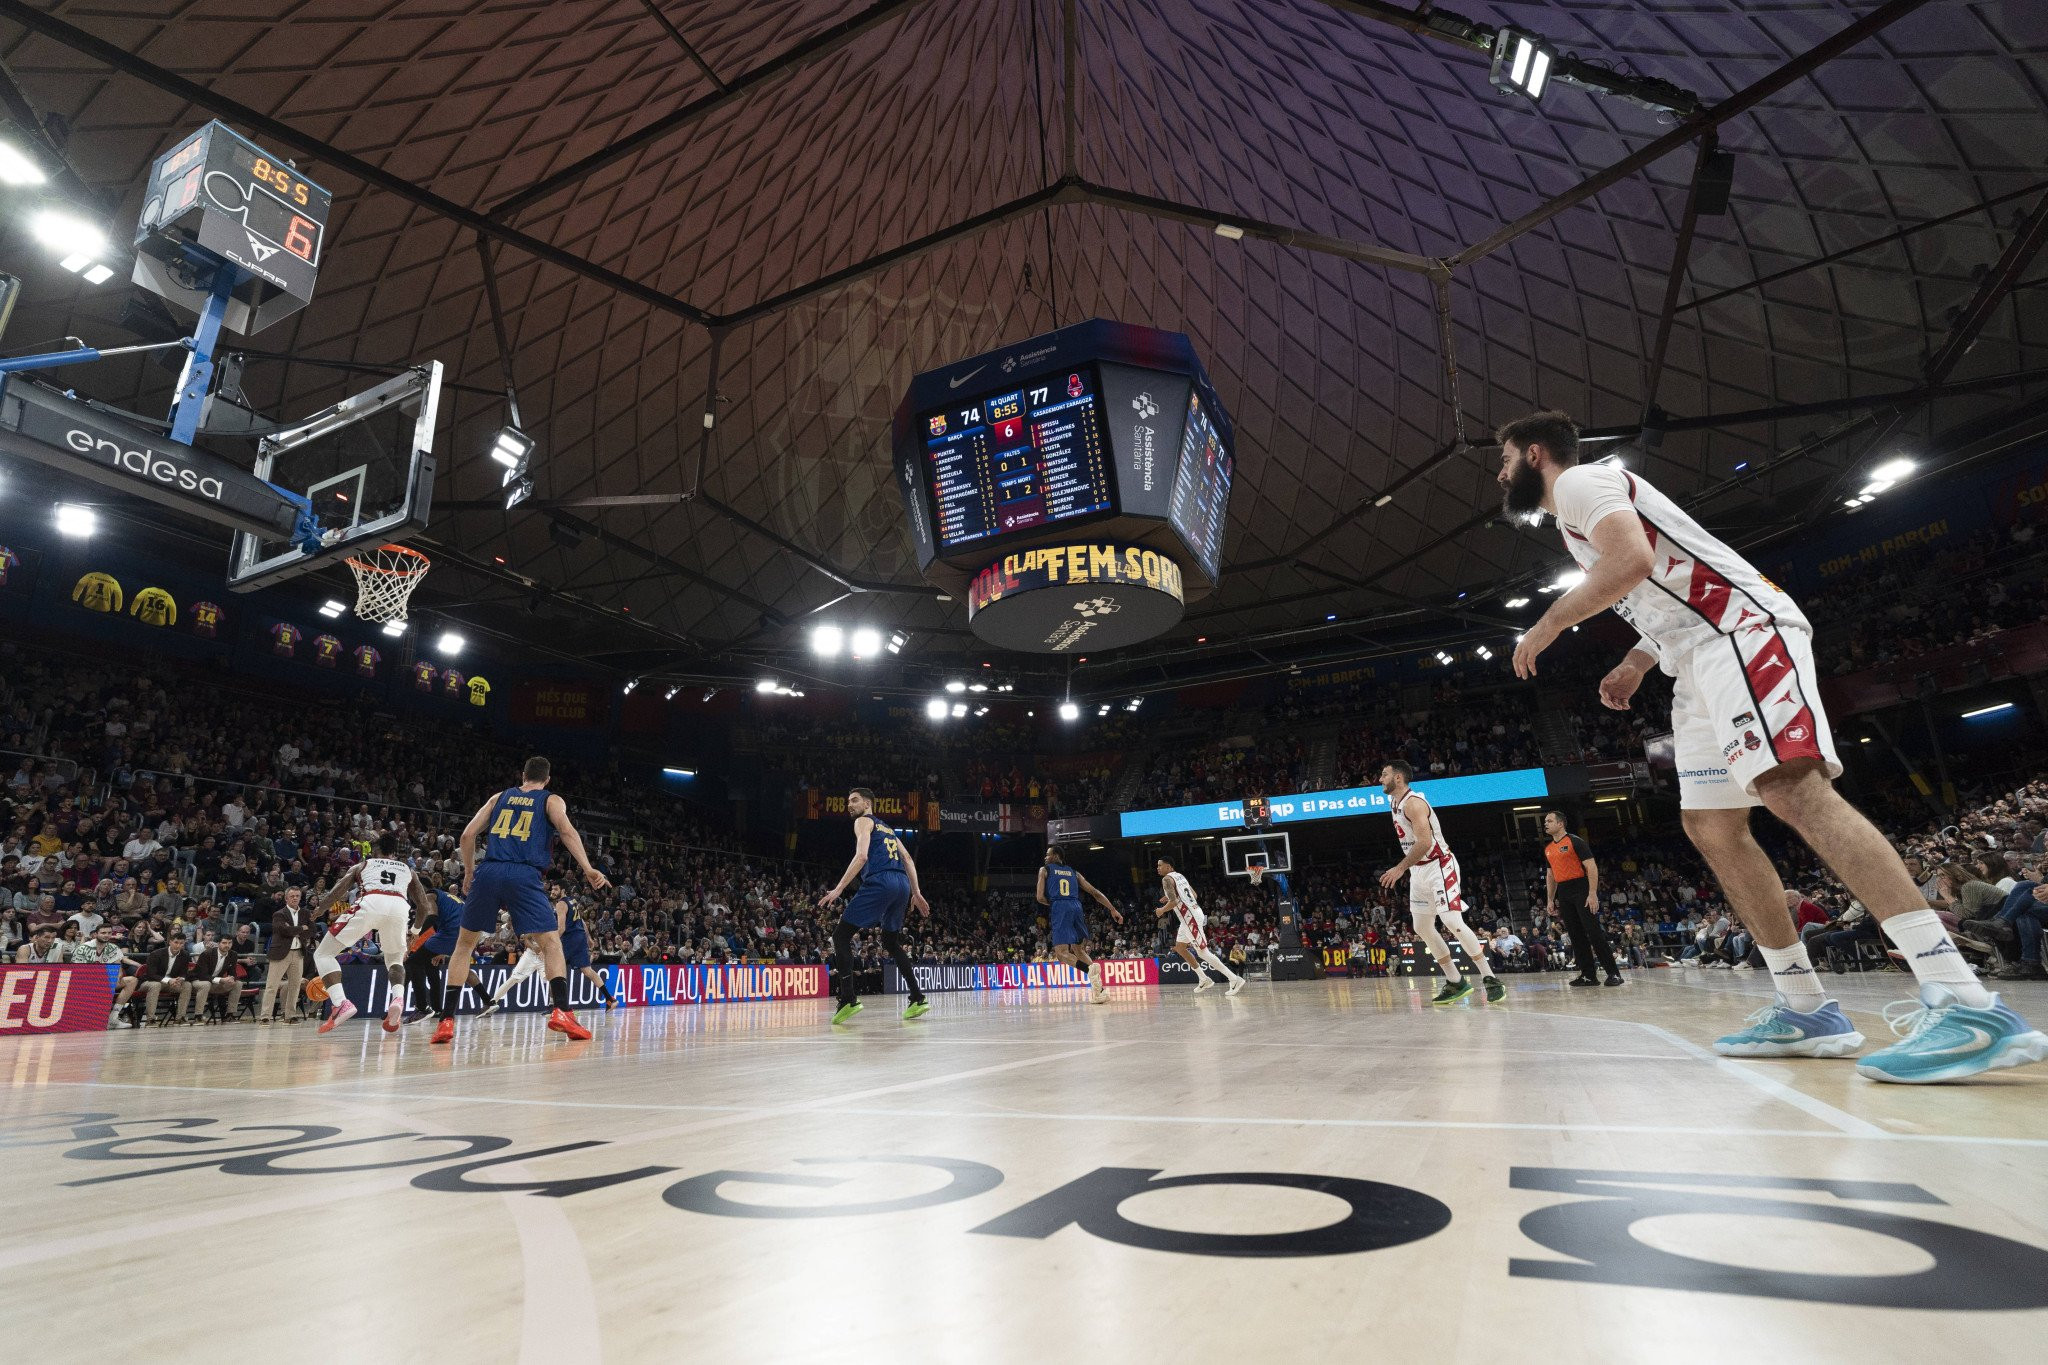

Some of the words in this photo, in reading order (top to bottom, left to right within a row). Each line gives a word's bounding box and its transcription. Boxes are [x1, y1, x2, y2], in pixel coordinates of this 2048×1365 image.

[253, 157, 309, 206] 8:55
[284, 215, 317, 260] 6
[225, 249, 287, 288] CUPRA
[998, 393, 1018, 404] QUART
[1030, 387, 1048, 405] 77
[994, 403, 1018, 418] 8:55
[1033, 405, 1066, 418] CASADEMONT
[1066, 397, 1093, 409] ZARAGOZA
[960, 408, 980, 425] 74
[1005, 425, 1013, 438] 6
[1041, 420, 1059, 429] SPISSU
[947, 434, 963, 442] BARÇA
[1004, 450, 1020, 458] FALTES
[1044, 444, 1060, 452] YUSTA
[1134, 425, 1144, 470] Sanitària
[66, 429, 224, 500] endesa
[1001, 462, 1007, 471] 0
[1022, 457, 1027, 466] 1
[1047, 458, 1068, 467] WATSON
[1144, 426, 1154, 491] Assistència
[1048, 463, 1077, 475] FERNÁNDEZ
[1006, 490, 1011, 499] 1
[1025, 485, 1031, 494] 2
[1048, 545, 1116, 581] FEM
[146, 596, 165, 611] 16
[472, 683, 485, 694] 28
[563, 692, 587, 704] QUE
[556, 706, 586, 718] CLUB
[1735, 717, 1750, 727] acb
[507, 796, 534, 807] PARRA
[1302, 801, 1316, 812] El
[1319, 800, 1344, 811] Pas
[1348, 797, 1366, 807] de
[1371, 794, 1384, 805] la
[940, 810, 967, 825] Sang
[975, 808, 999, 821] Culé
[490, 809, 535, 842] 44
[1059, 879, 1069, 896] 0
[943, 965, 956, 990] UN
[1027, 962, 1044, 987] AL
[1105, 961, 1145, 984] PREU
[614, 969, 638, 1002] AL
[643, 968, 702, 1004] PALAU,
[705, 969, 725, 999] AL
[728, 968, 781, 998] MILLOR
[785, 968, 818, 996] PREU
